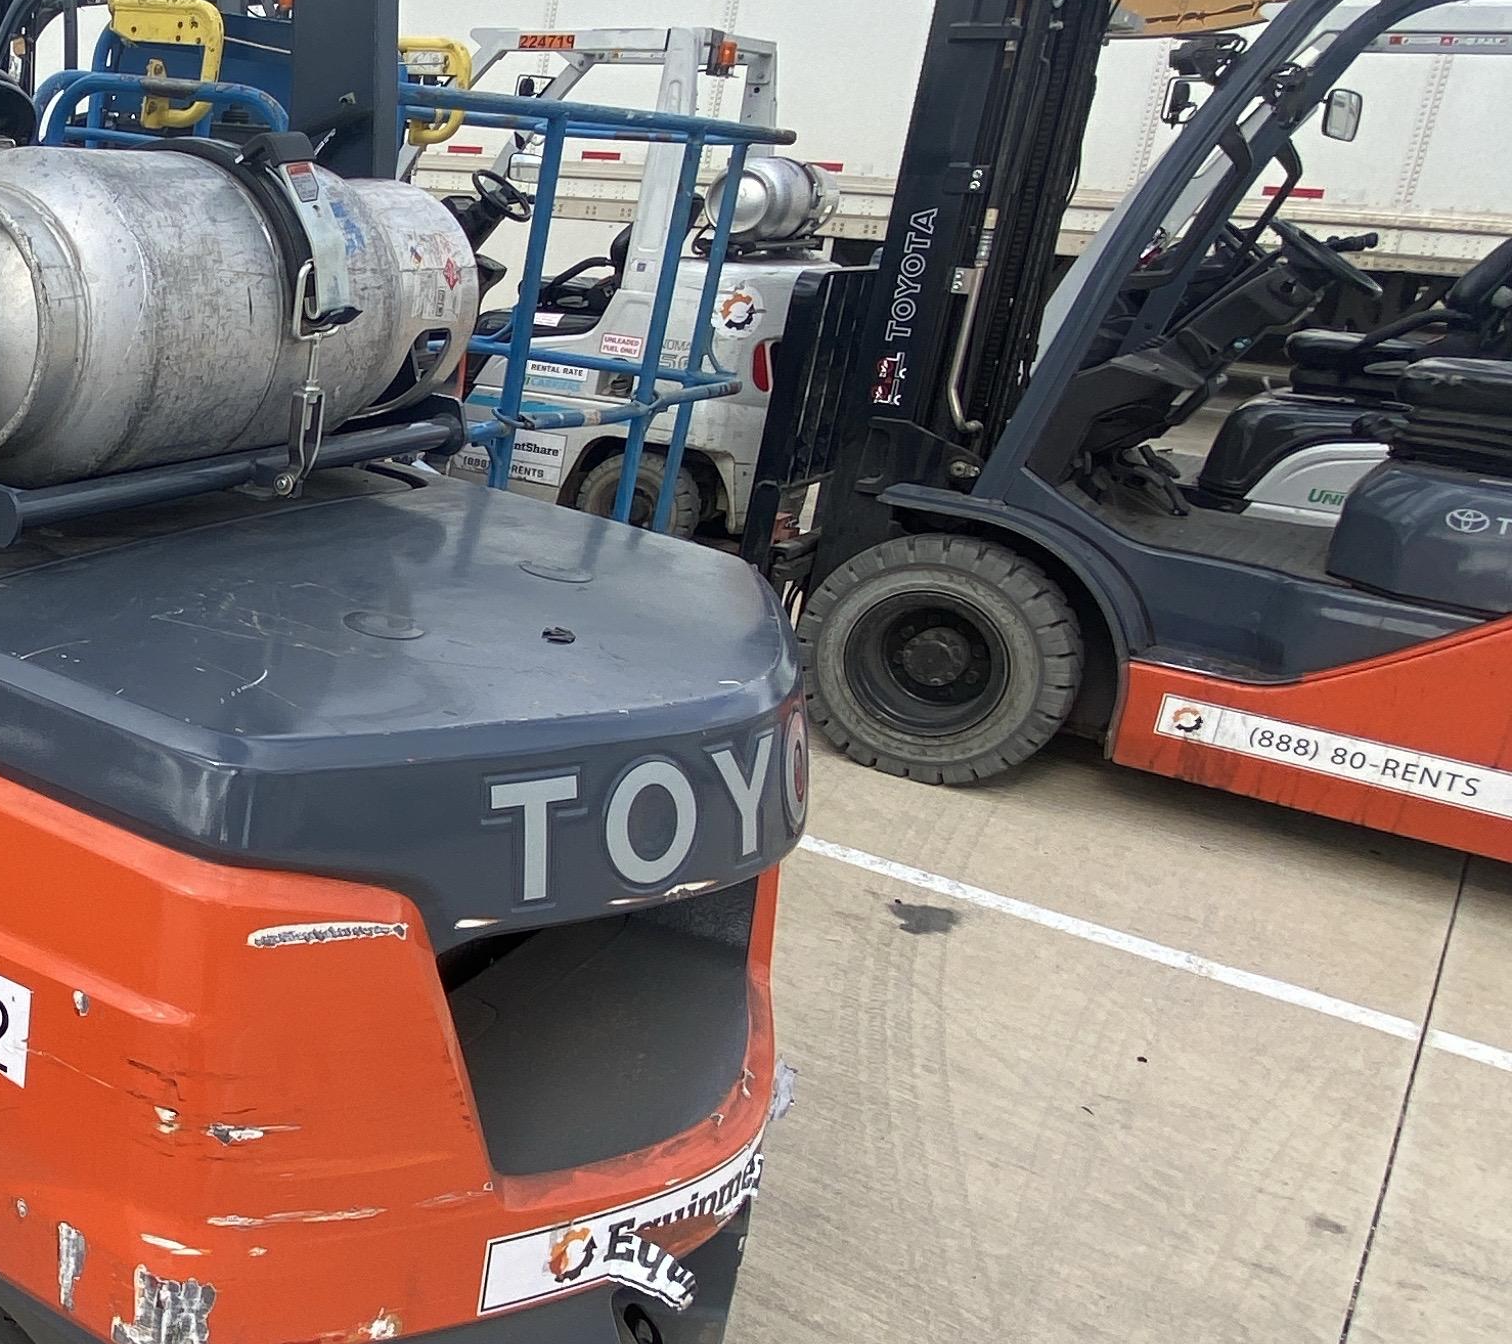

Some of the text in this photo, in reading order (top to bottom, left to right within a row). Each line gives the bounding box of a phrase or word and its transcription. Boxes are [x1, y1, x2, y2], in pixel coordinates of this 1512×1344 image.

[518, 34, 576, 49] 224719
[884, 207, 939, 342] TOYOTA
[604, 336, 640, 347] UNLEADED
[620, 347, 638, 355] ONLY
[531, 363, 584, 377] RENTAL RATE
[514, 441, 560, 457] ntShare
[511, 464, 545, 478] RENTS
[1249, 726, 1482, 798] (888) 80-RENTS
